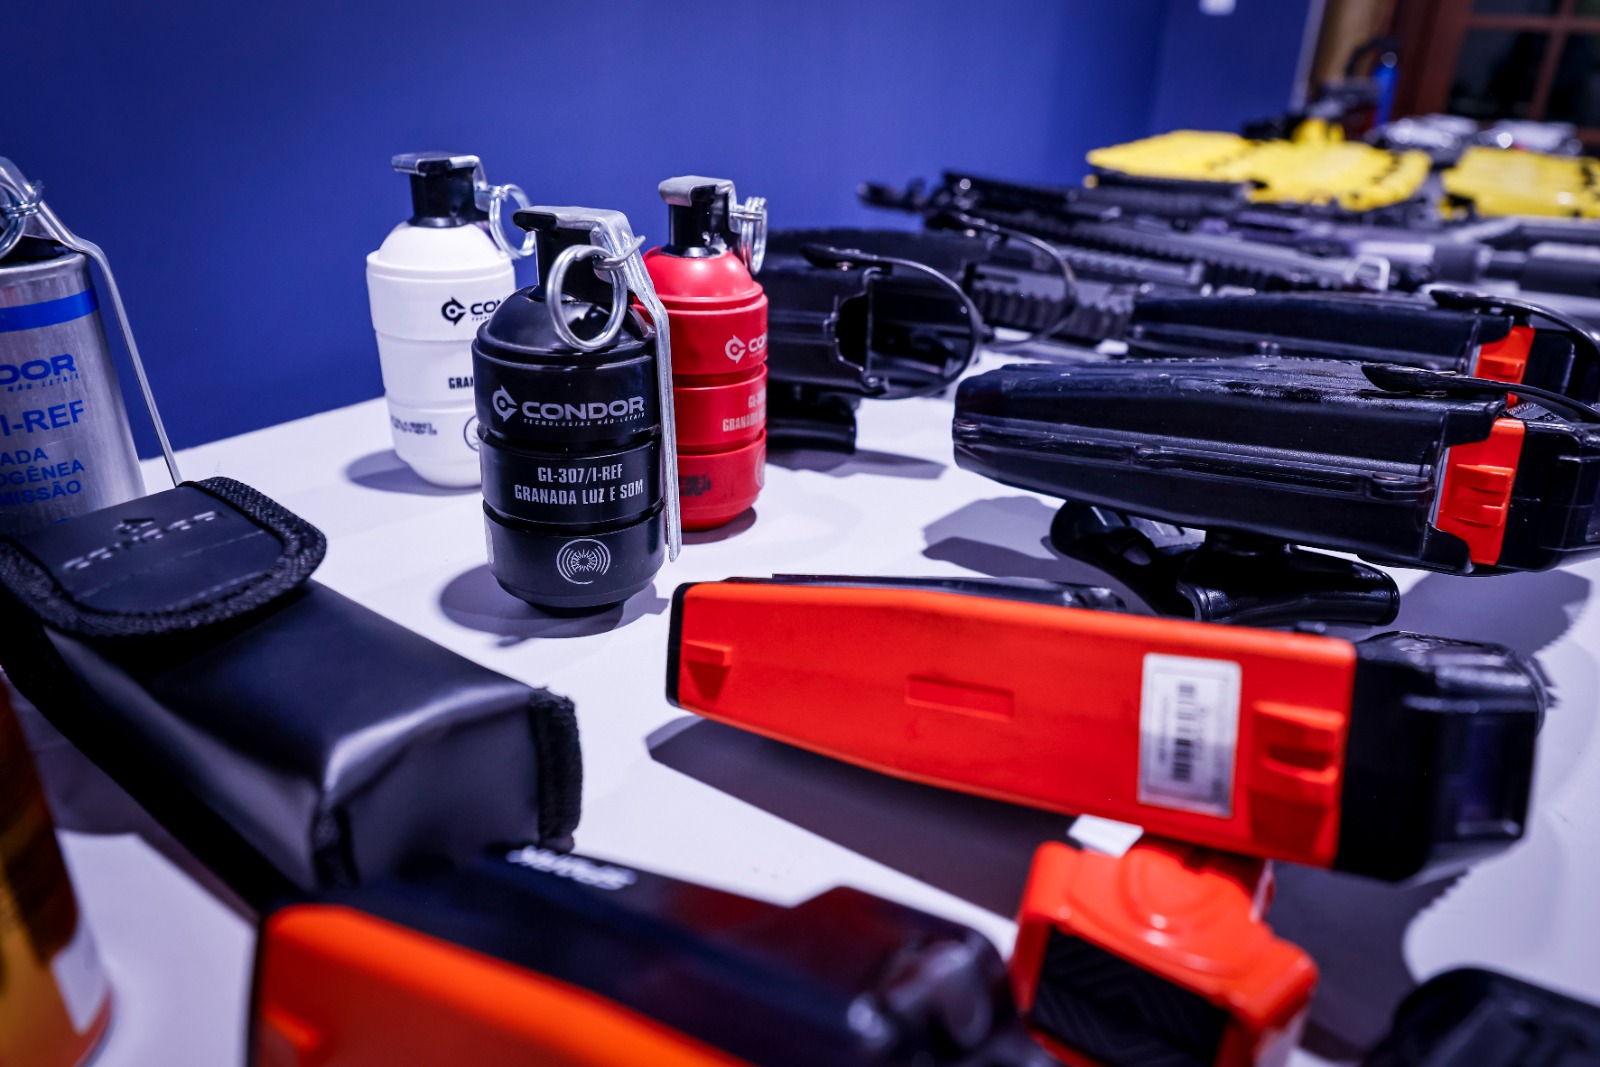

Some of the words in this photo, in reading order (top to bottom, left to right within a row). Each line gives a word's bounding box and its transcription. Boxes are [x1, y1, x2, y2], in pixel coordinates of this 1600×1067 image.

[470, 300, 501, 315] CO
[521, 395, 645, 420] CONDOR
[537, 463, 623, 485] GL-307/I-REF
[514, 484, 577, 505] GRANADA
[582, 488, 605, 505] LUZ
[609, 486, 616, 501] E
[620, 479, 644, 499] SOM
